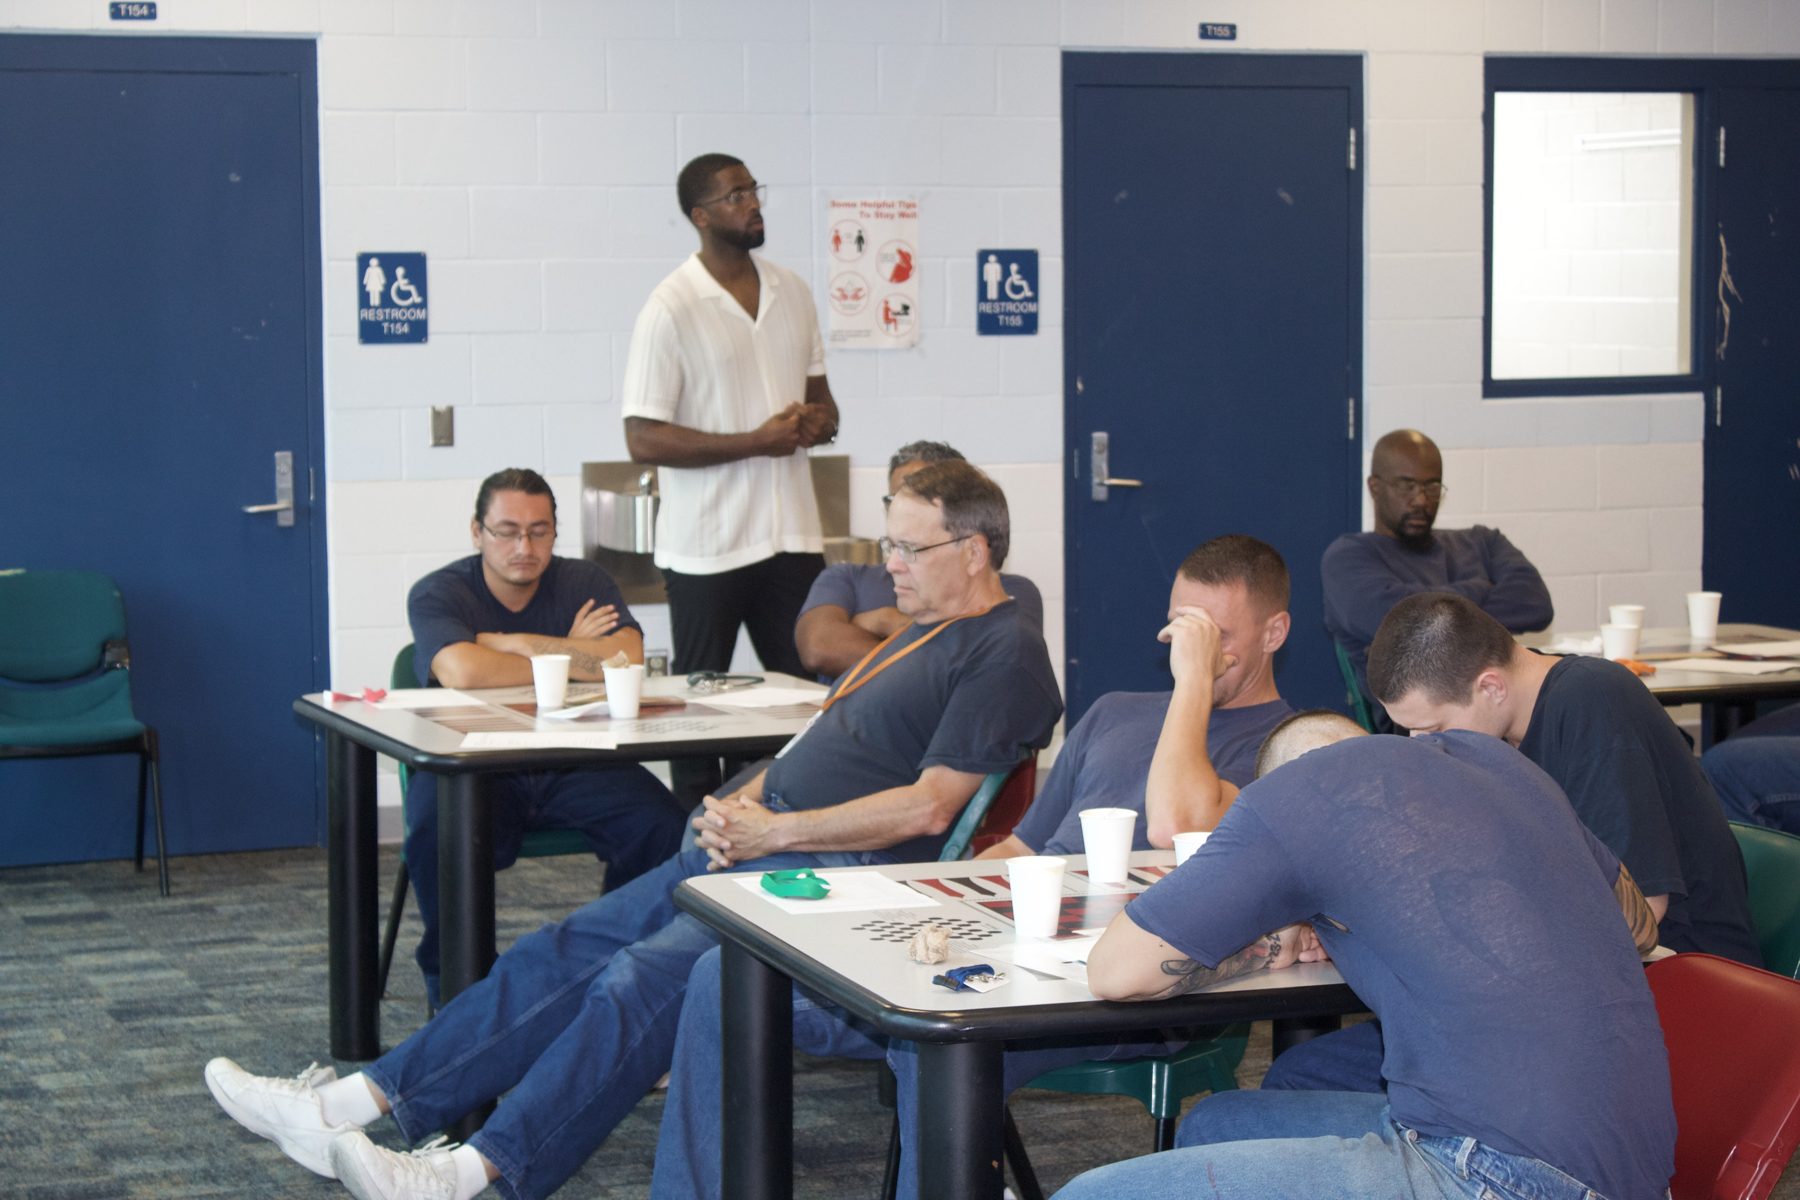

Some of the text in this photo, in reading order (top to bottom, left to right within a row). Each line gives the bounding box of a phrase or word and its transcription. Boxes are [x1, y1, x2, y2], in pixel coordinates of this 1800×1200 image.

[118, 4, 148, 16] T154
[1206, 25, 1231, 37] T155
[860, 201, 894, 209] Helpful
[979, 302, 1037, 313] RESTROOM
[360, 308, 426, 320] RESTROOM
[998, 315, 1022, 326] T155
[382, 323, 409, 335] T154
